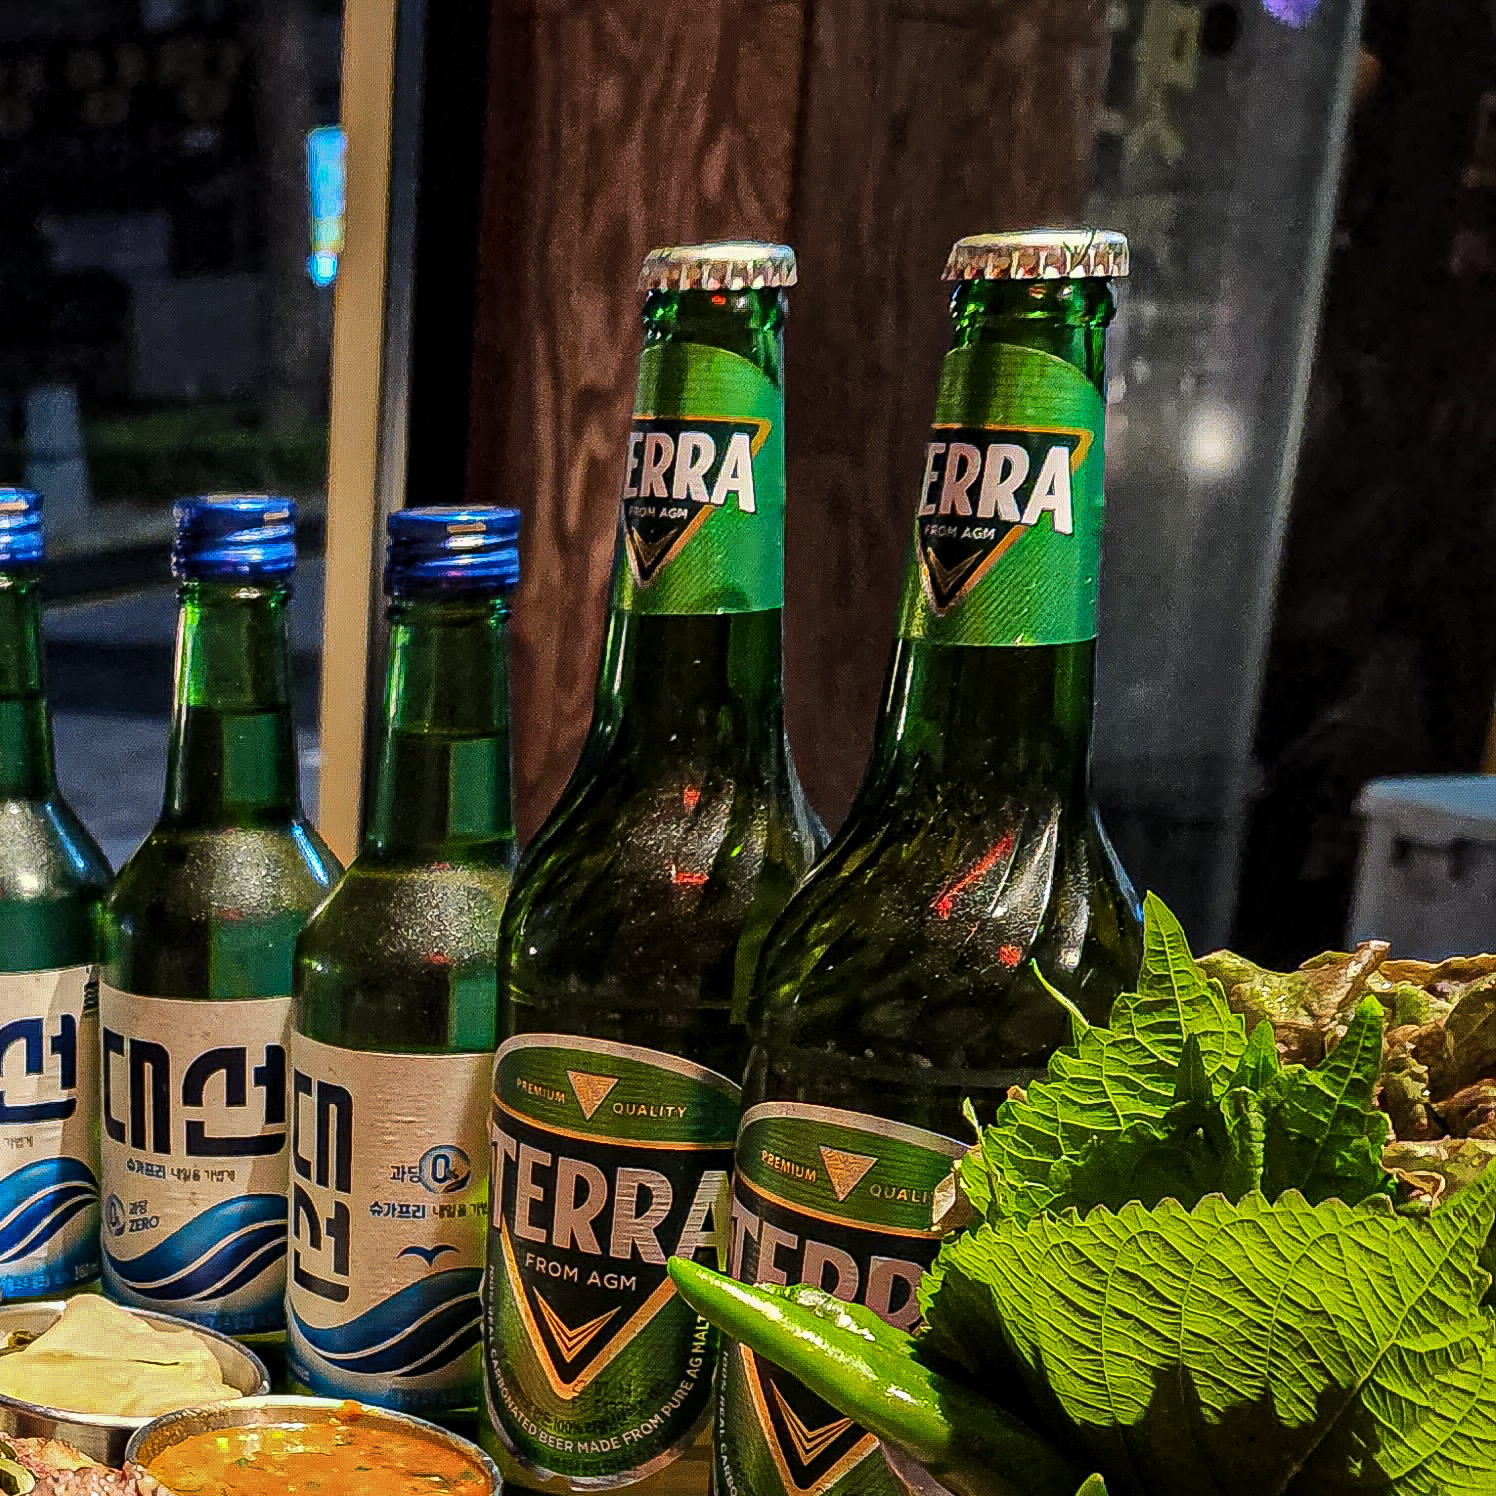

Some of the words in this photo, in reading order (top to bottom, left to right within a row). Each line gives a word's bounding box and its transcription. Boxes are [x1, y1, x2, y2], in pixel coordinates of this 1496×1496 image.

[623, 430, 756, 514] ERRA
[918, 442, 1074, 535] ERRA
[516, 1076, 565, 1104] PREMIUM
[612, 1102, 687, 1119] QUALITY
[761, 1150, 816, 1183] PREMIUM
[869, 1183, 927, 1204] QUALI
[369, 1201, 426, 1219] 슈가프리
[490, 1127, 732, 1273] TERRA
[128, 1216, 160, 1233] ZERO
[525, 1252, 579, 1283] FROM
[587, 1271, 637, 1292] AGM
[691, 1314, 710, 1353] MALT
[685, 1356, 703, 1379] AG
[490, 1348, 537, 1436] CARBONATED
[660, 1379, 695, 1417] PURE
[539, 1432, 574, 1453] BEER
[577, 1436, 622, 1454] MADE
[622, 1413, 665, 1446] FROM
